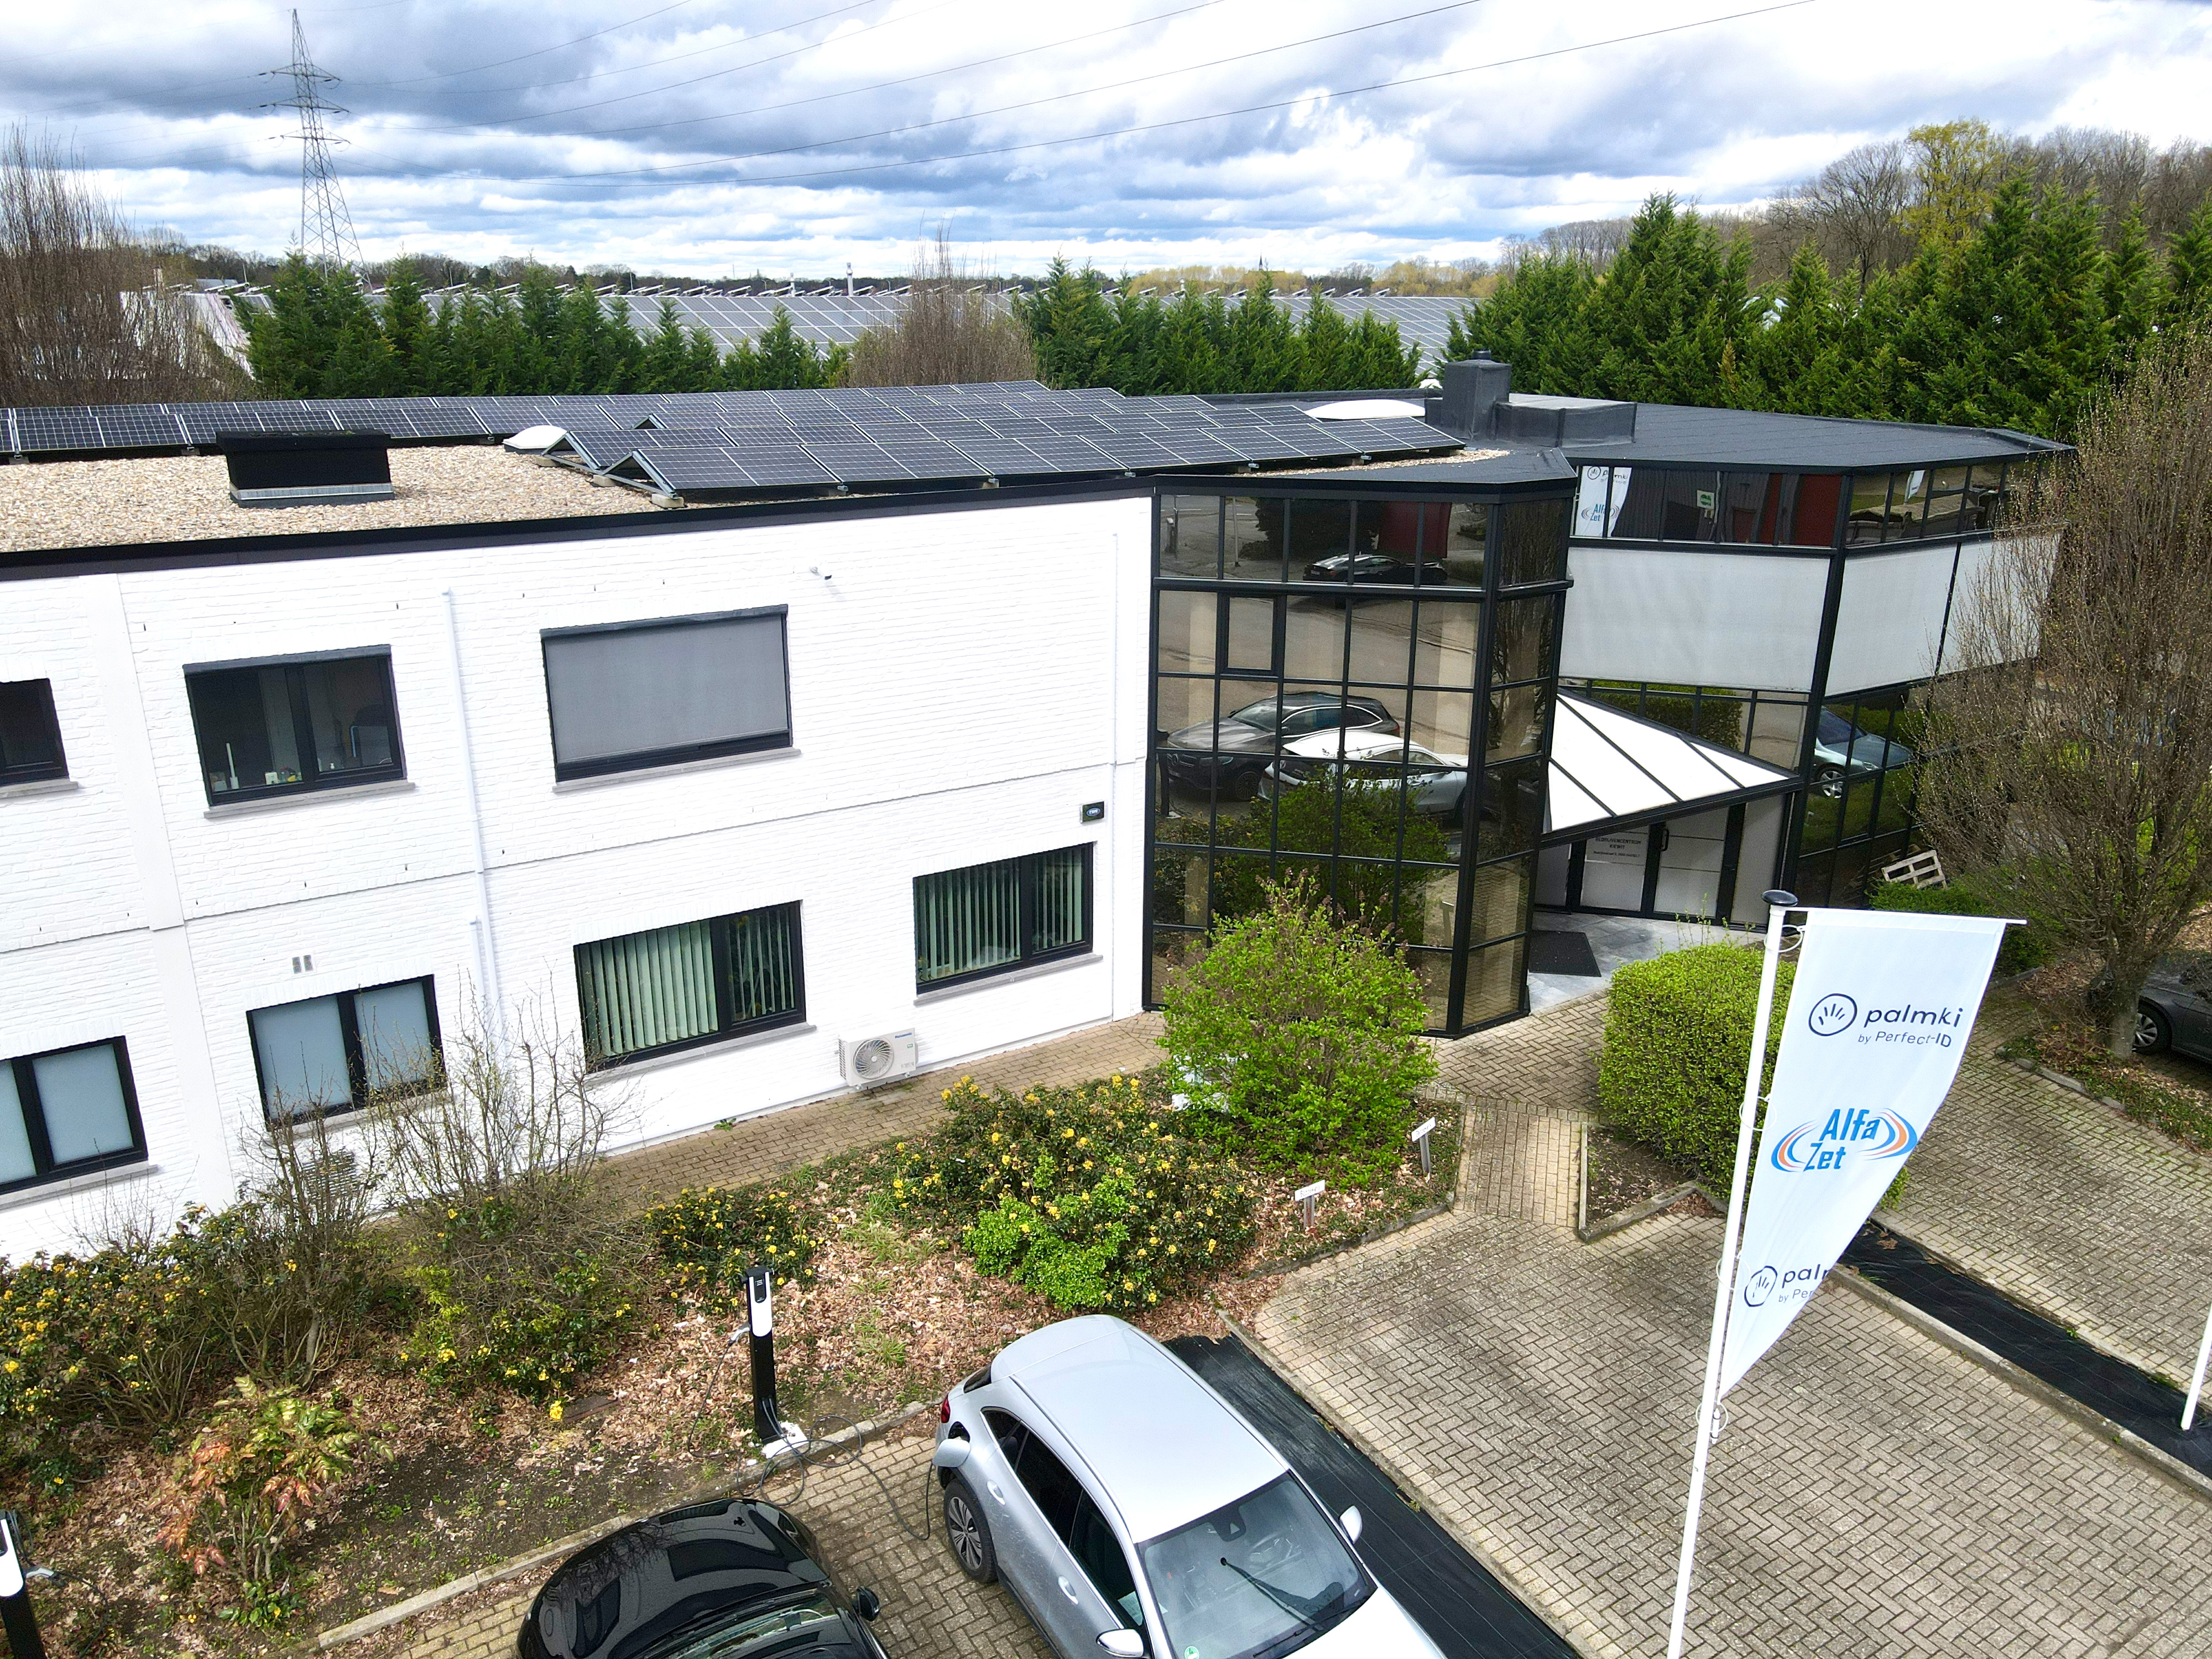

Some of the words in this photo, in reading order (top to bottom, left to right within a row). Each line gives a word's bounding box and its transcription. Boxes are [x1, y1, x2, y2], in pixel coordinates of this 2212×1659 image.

[1864, 1004, 1963, 1028] palmki
[1858, 1034, 1872, 1045] by
[1875, 1031, 1952, 1047] Perfect-ID
[1818, 1108, 1881, 1141] Alfa
[1802, 1142, 1846, 1172] Zet
[1778, 1295, 1789, 1303] by
